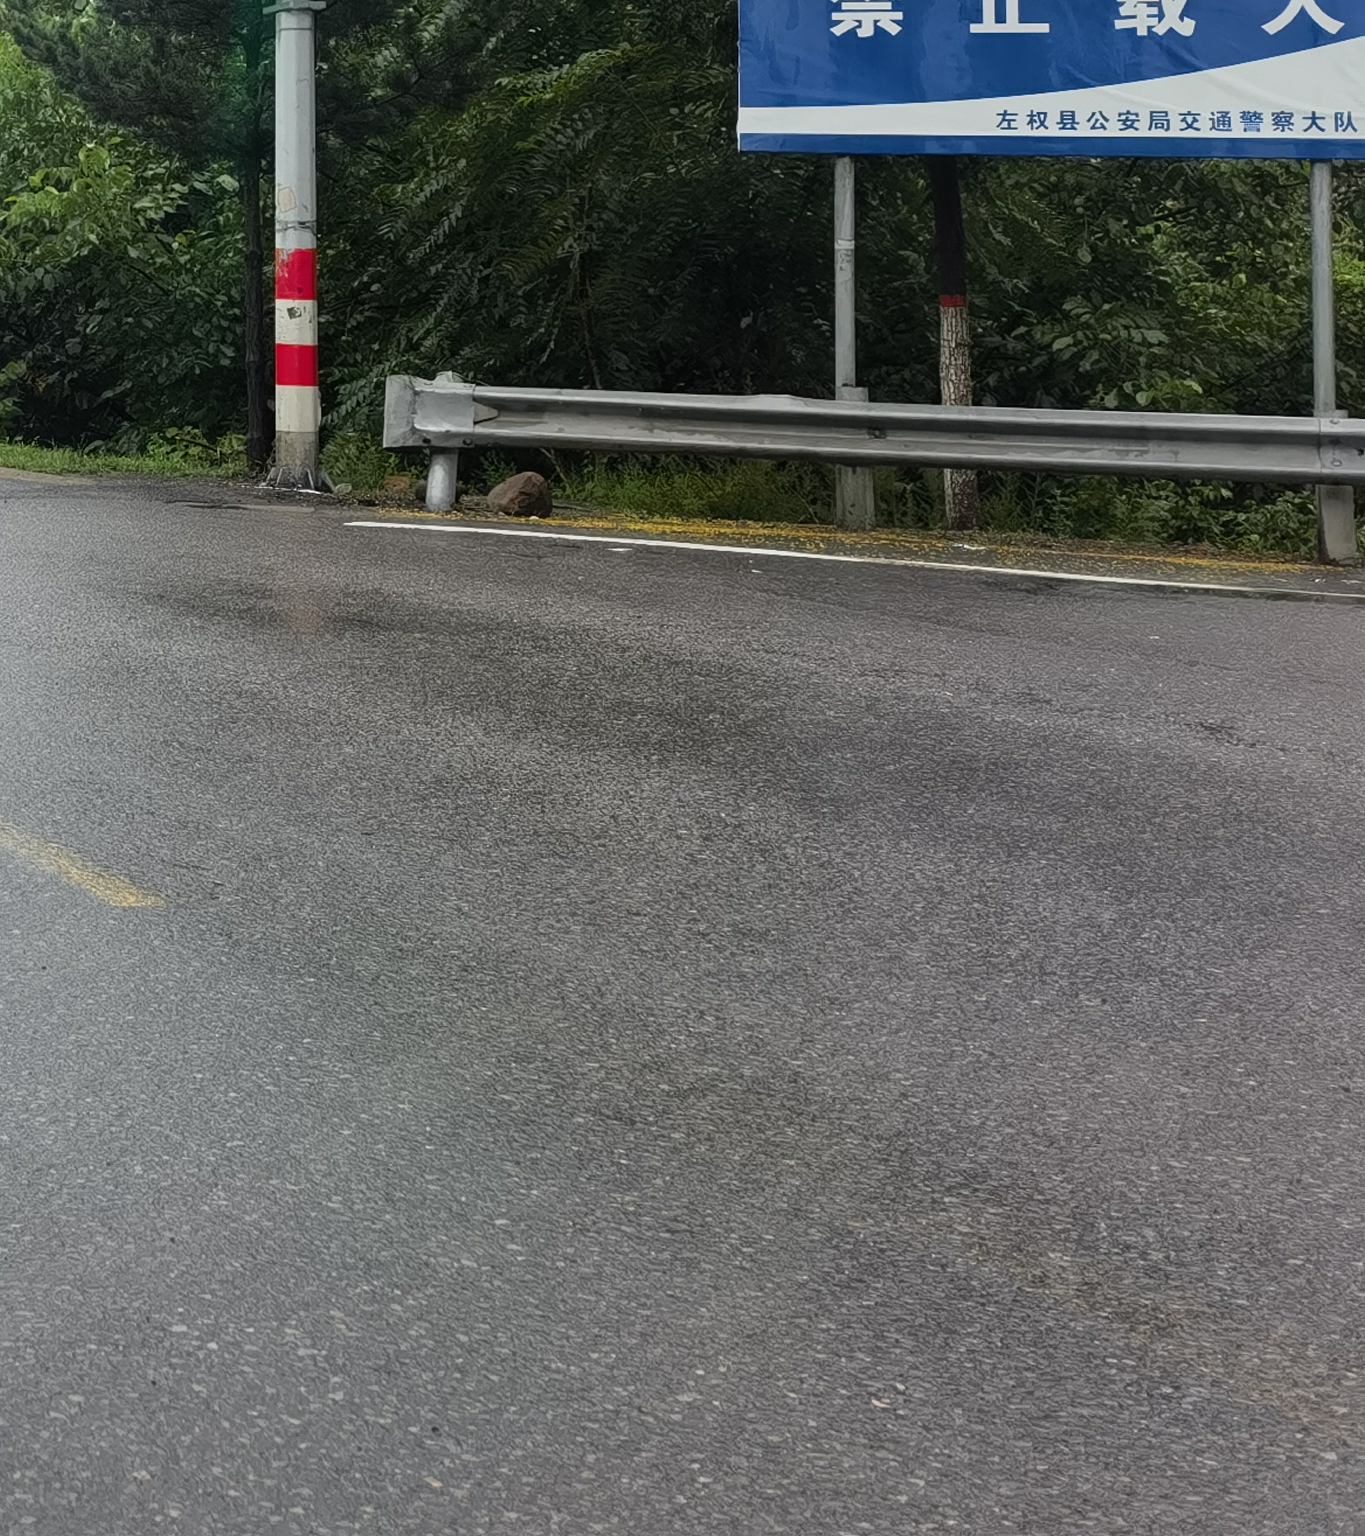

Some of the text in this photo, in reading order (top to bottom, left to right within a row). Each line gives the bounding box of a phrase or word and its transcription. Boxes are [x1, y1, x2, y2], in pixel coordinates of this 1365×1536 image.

[995, 109, 1358, 133] 左权县公安局交通警察大队
